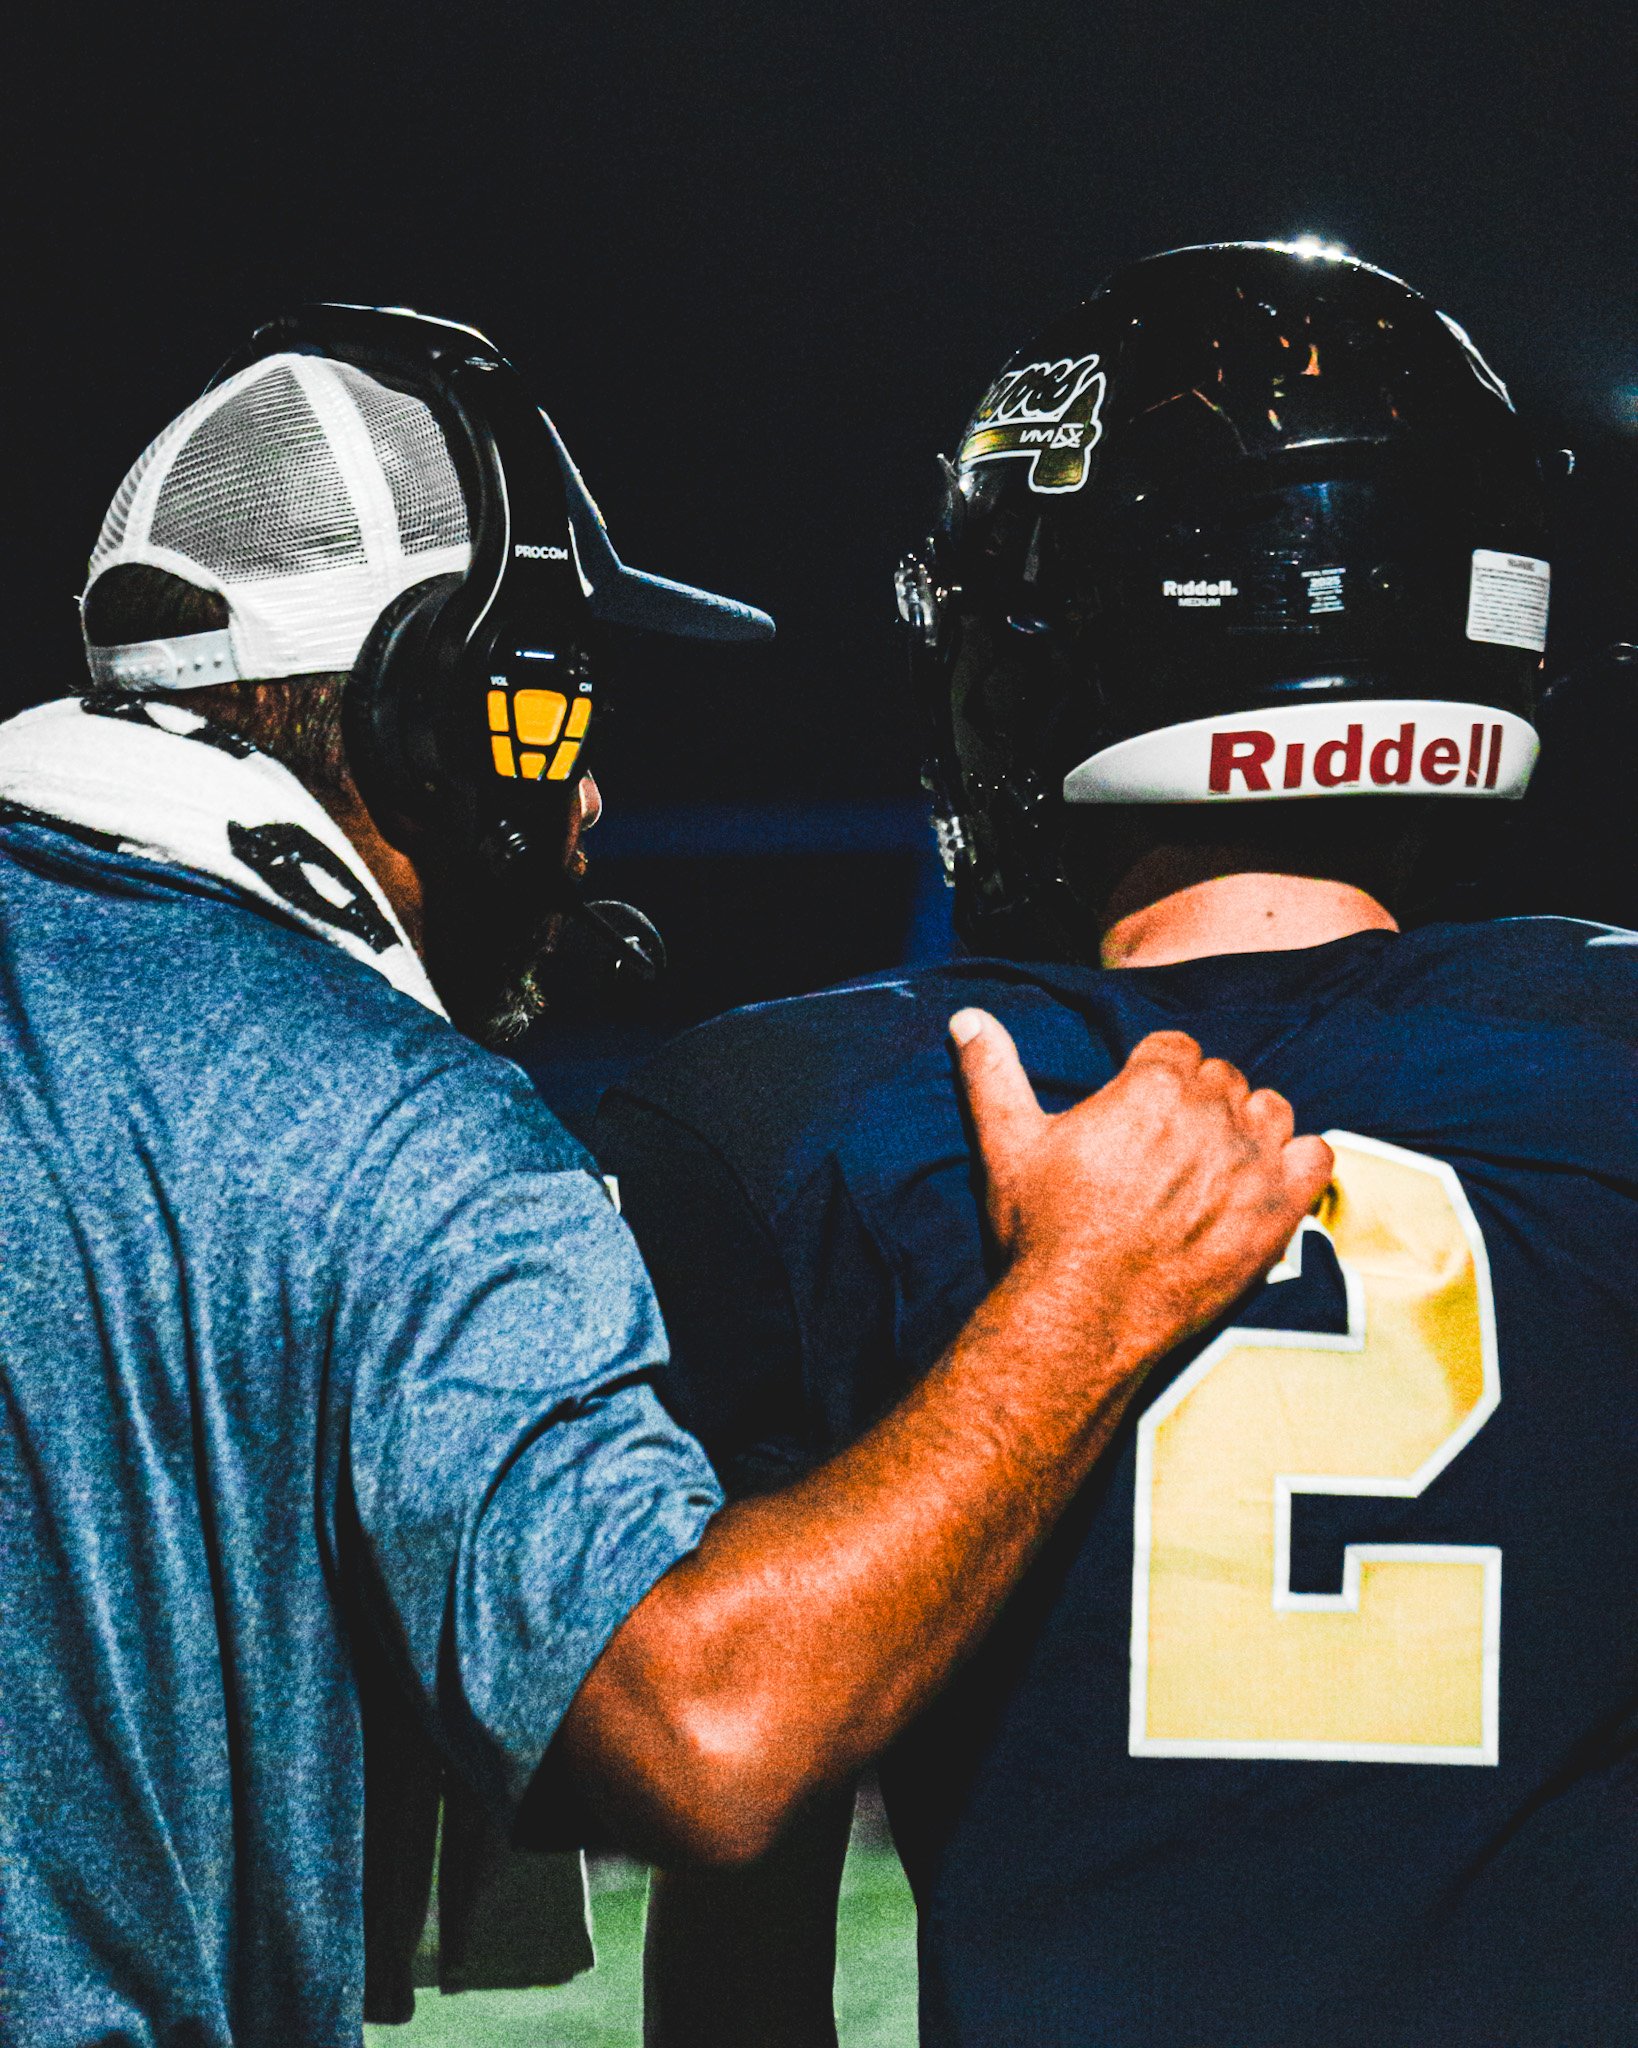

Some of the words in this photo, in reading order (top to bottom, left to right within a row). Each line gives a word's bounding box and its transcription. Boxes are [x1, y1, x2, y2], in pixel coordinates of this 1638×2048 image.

[515, 544, 568, 560] PROCOM
[490, 676, 509, 687] VOL
[1208, 722, 1503, 794] Riddell
[1129, 1129, 1502, 1766] 2
